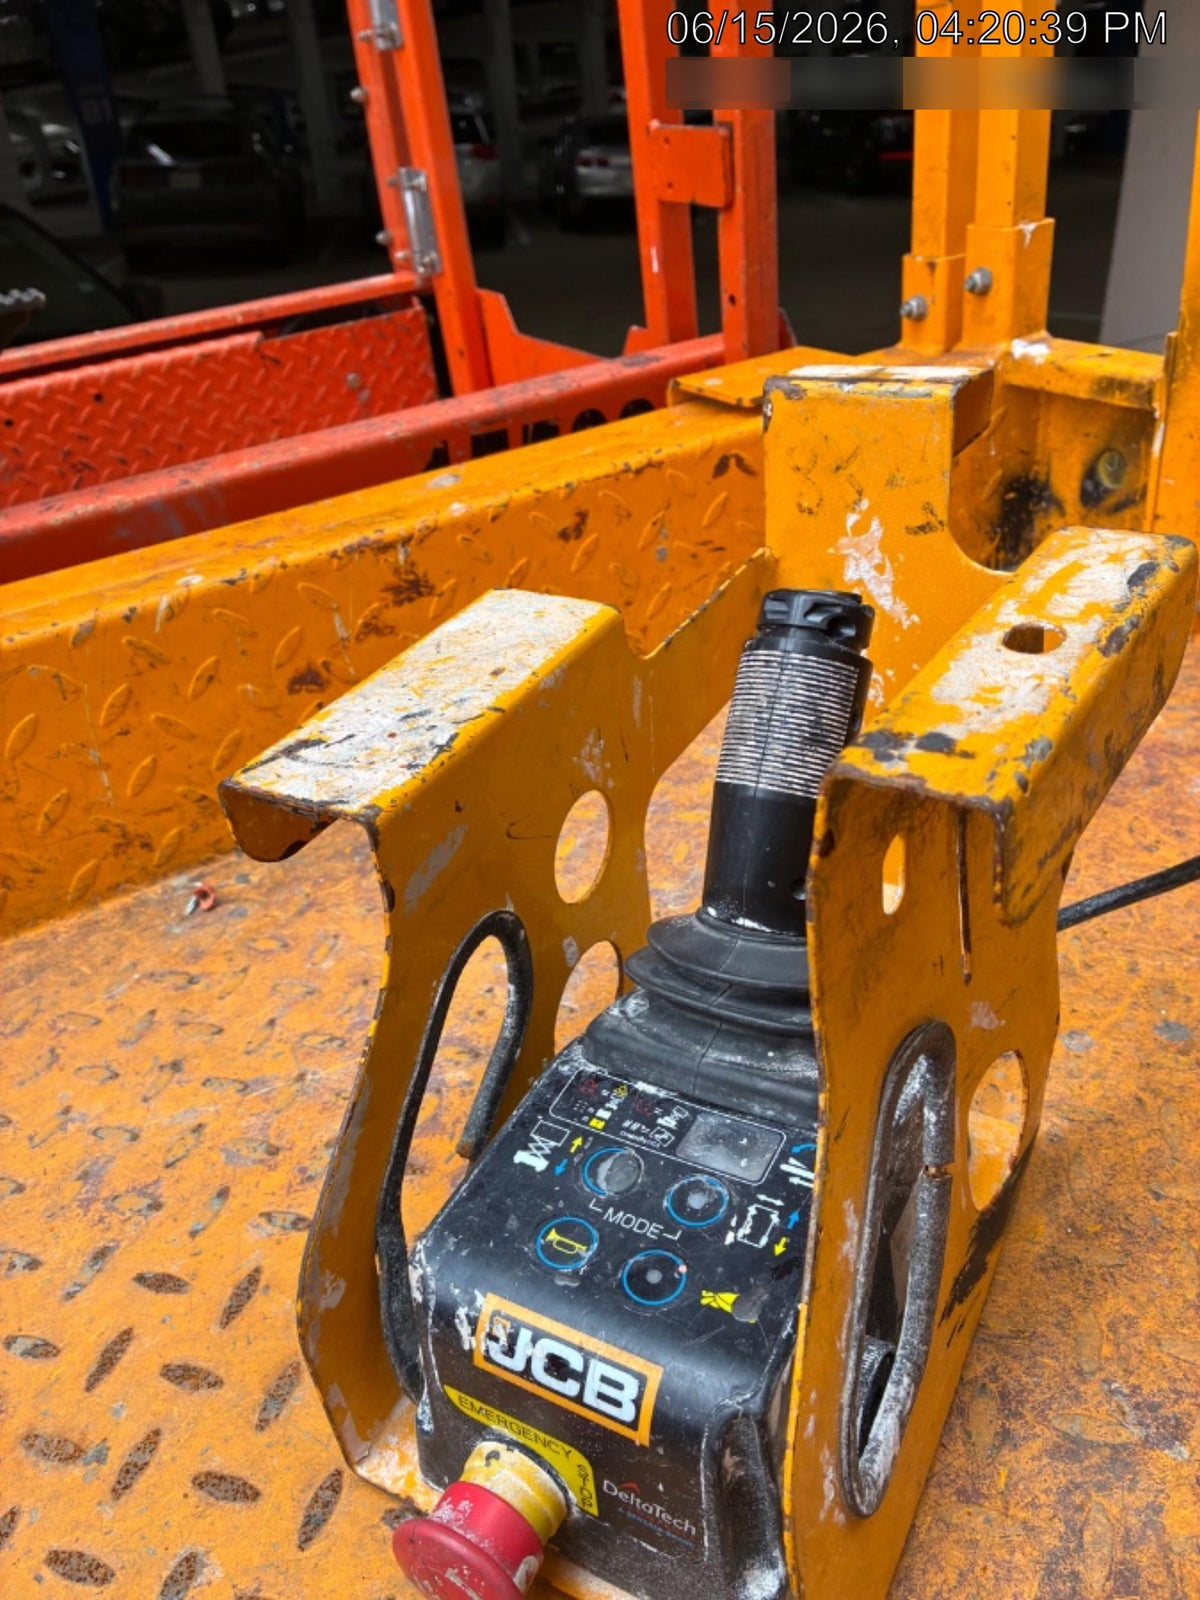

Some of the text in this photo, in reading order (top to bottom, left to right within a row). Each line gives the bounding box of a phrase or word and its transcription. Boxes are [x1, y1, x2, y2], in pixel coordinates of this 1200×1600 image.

[603, 1208, 664, 1240] MODE
[487, 1326, 640, 1424] JCB
[458, 1394, 572, 1459] EMERGENCY
